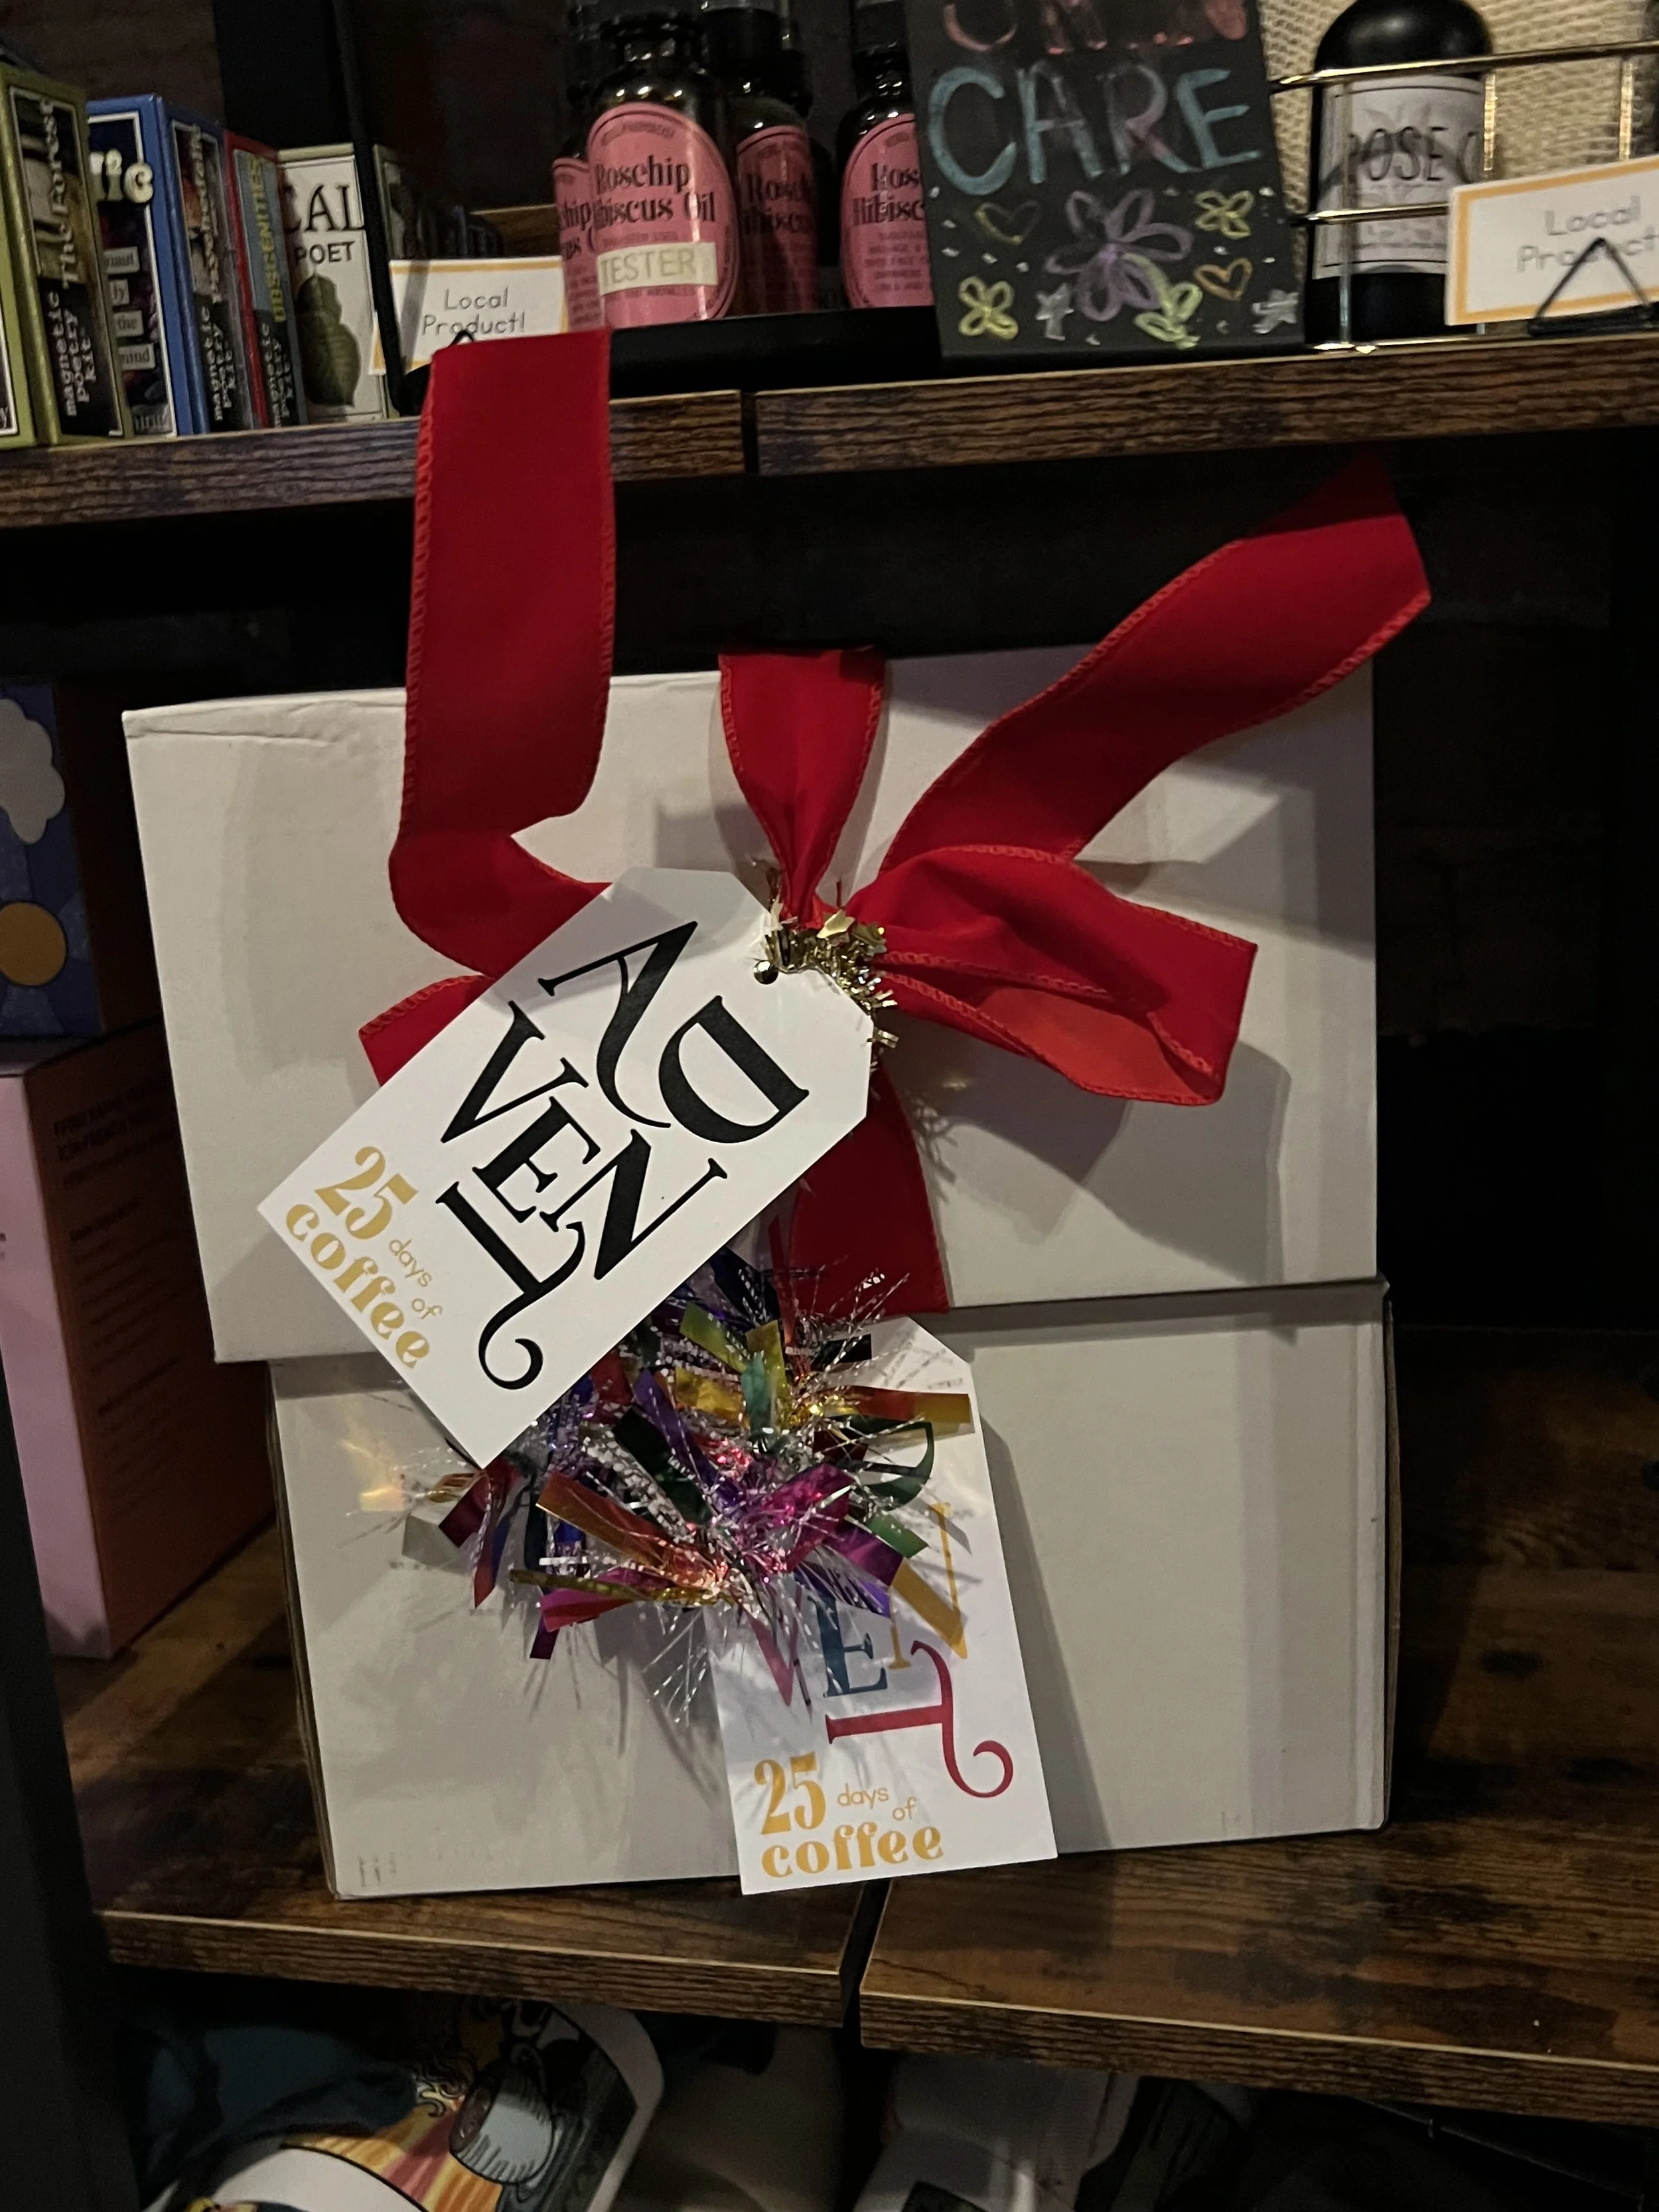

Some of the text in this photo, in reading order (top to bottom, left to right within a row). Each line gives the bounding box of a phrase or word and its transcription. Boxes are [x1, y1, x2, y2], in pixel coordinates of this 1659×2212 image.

[929, 60, 1260, 195] CARE
[1544, 195, 1642, 236] Local
[599, 248, 695, 287] TESTER
[421, 311, 526, 336] Product!
[444, 286, 509, 311] Local
[315, 1146, 443, 1320] 25 days of
[286, 1204, 430, 1369] coffee
[754, 1751, 917, 1835] 25 days of
[761, 1822, 944, 1878] coffee
